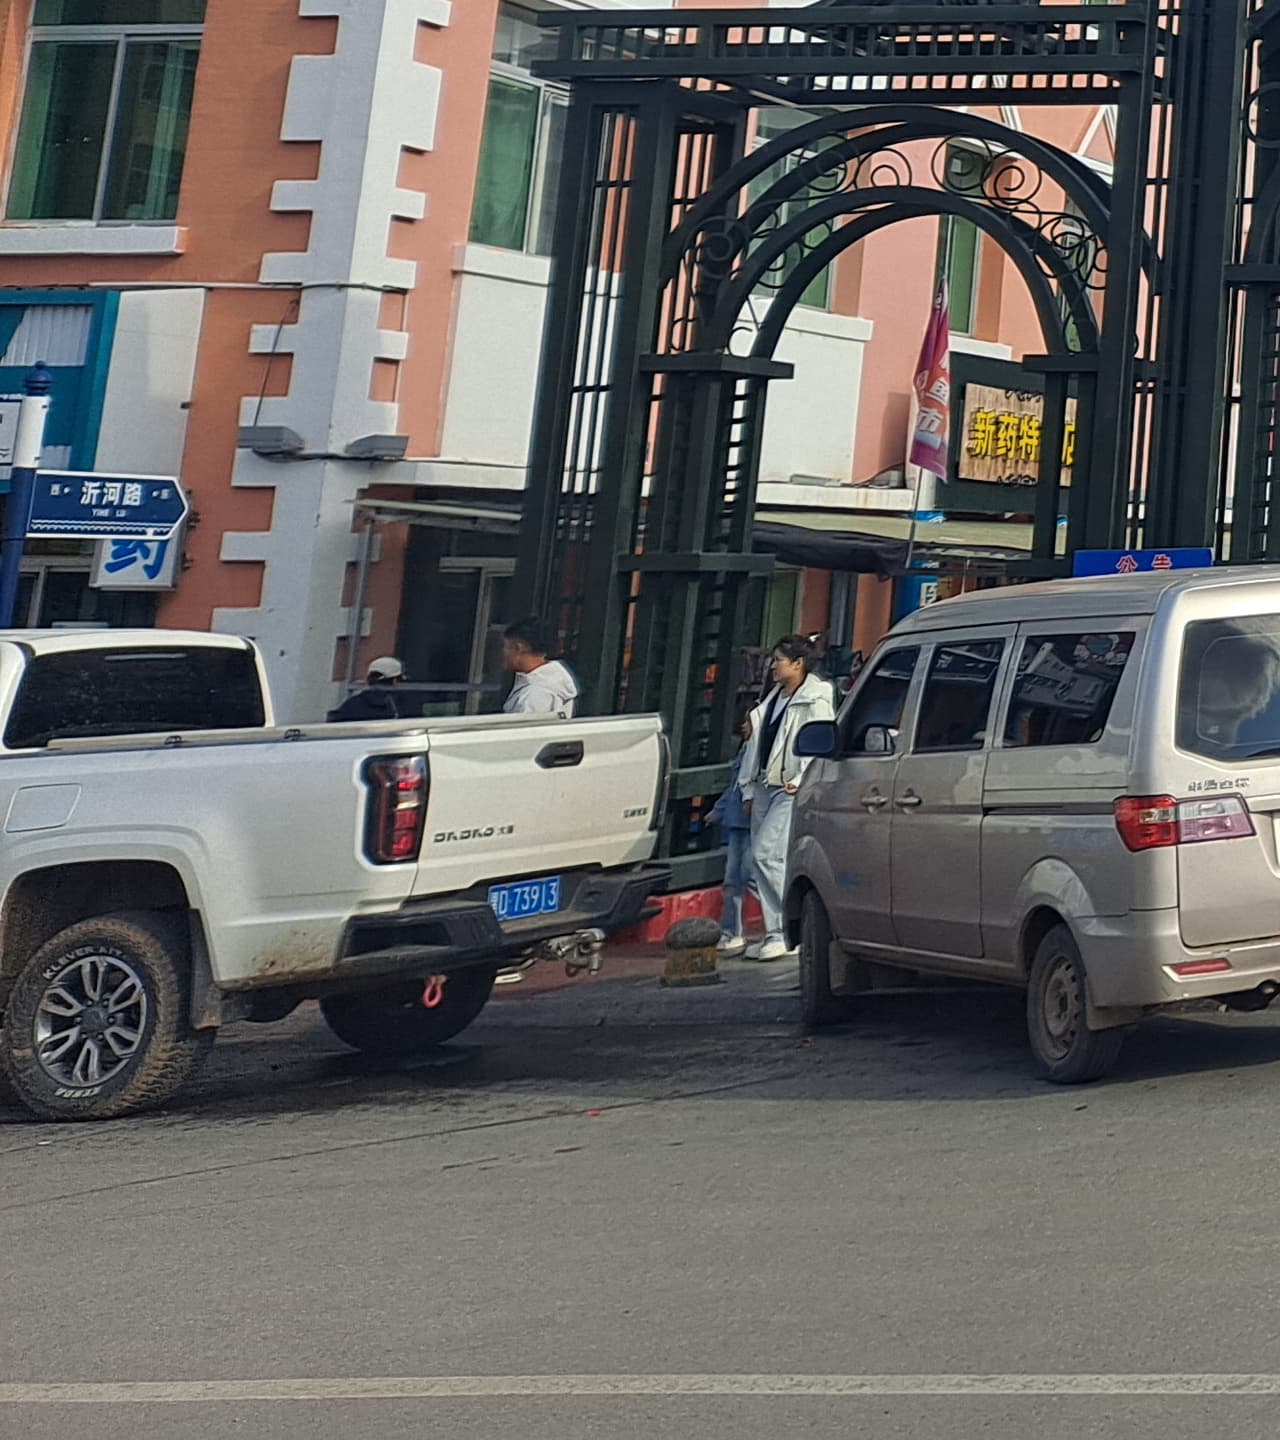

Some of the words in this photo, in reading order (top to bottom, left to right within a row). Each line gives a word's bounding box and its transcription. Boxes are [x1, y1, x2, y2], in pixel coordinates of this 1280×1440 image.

[80, 480, 143, 507] 沂河路
[42, 946, 94, 980] KLEVER
